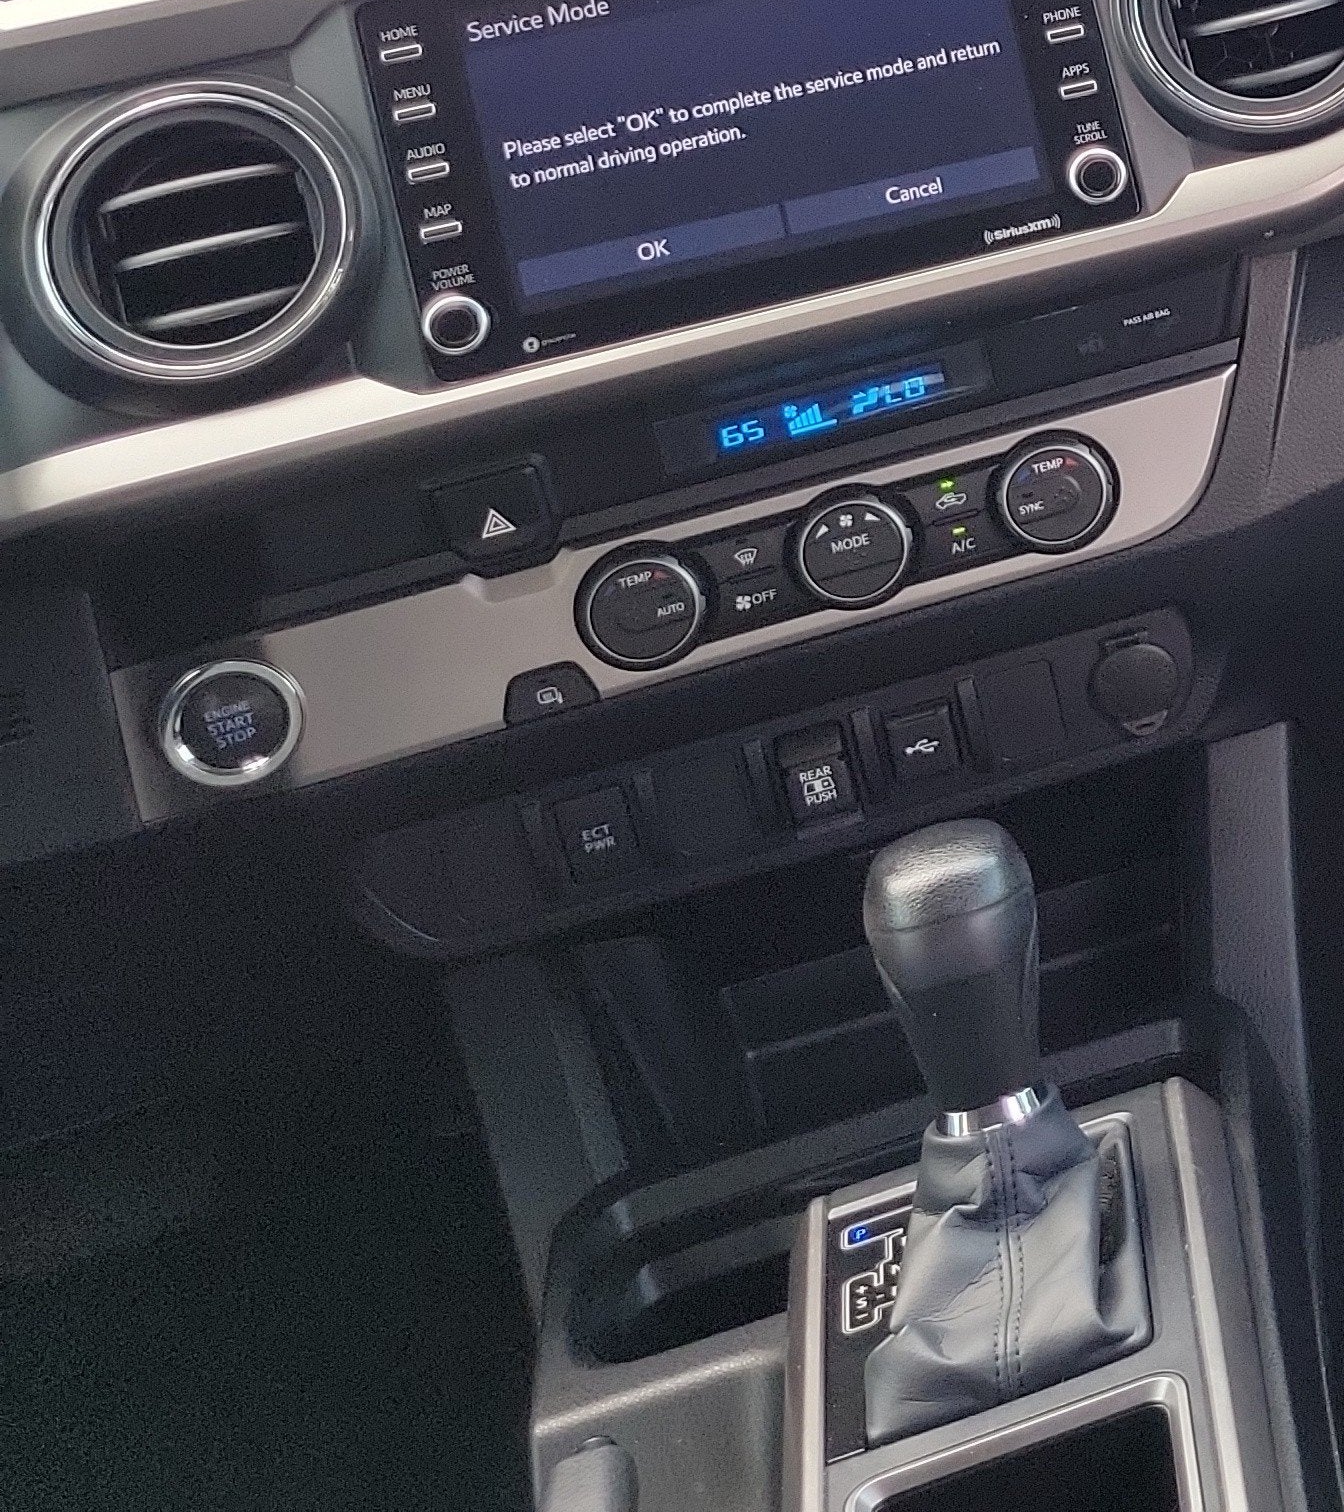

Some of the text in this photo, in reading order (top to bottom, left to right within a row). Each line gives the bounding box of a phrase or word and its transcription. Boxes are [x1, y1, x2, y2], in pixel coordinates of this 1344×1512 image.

[1043, 6, 1082, 24] PHONE
[380, 25, 418, 42] HOME
[466, 13, 544, 42] Service
[1062, 63, 1090, 78] APPS
[393, 84, 431, 101] MENU
[503, 41, 1001, 159] Please select "OK" to complete the service mode and return
[1076, 120, 1101, 134] TUNE
[1073, 129, 1108, 145] SCROLL
[406, 143, 446, 161] AUDIO
[510, 126, 747, 188] to normal driving operation.
[885, 176, 944, 204] Cancel
[423, 203, 453, 219] MAP
[637, 238, 671, 261] OK
[432, 263, 470, 281] POWER
[431, 273, 477, 291] VOLUME
[1123, 315, 1143, 327] PASS
[1155, 308, 1171, 319] BAG
[720, 420, 765, 448] 65
[1031, 457, 1065, 475] TEMP
[1018, 500, 1045, 516] SYNC
[830, 533, 871, 554] MODE
[951, 537, 976, 555] A/C
[618, 570, 652, 589] TEMP
[751, 588, 778, 606] OFF
[657, 601, 685, 618] AUTO
[204, 700, 251, 723] ENGINE
[207, 712, 254, 736] START
[216, 727, 257, 749] STOP
[799, 765, 832, 783] REAR
[805, 787, 838, 806] PUSH
[581, 823, 611, 841] ECT
[584, 835, 616, 854] PWR
[855, 1228, 867, 1241] P
[855, 1296, 868, 1309] S
